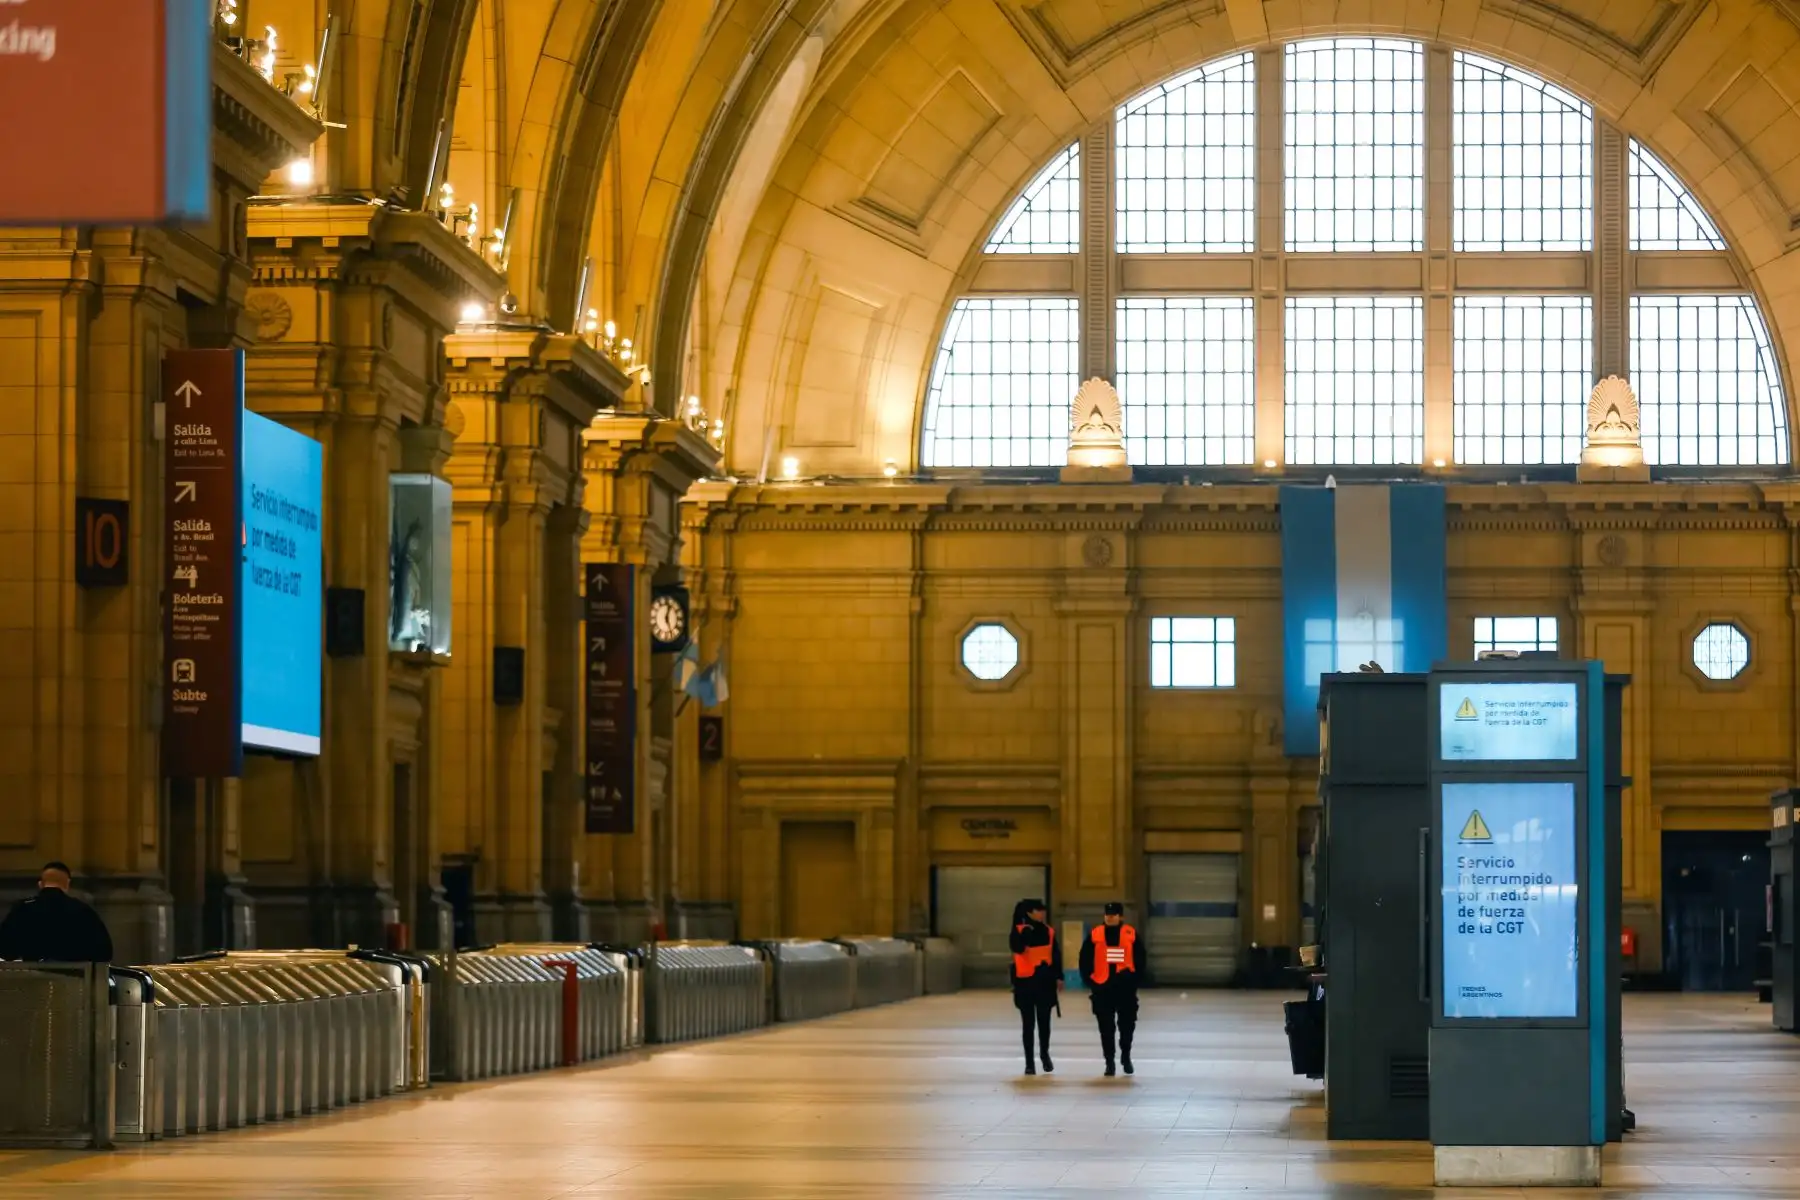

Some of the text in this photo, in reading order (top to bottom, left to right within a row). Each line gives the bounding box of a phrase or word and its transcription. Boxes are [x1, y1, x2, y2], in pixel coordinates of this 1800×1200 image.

[174, 424, 212, 436] Salida
[199, 437, 218, 445] Lima
[251, 483, 278, 517] Servicio
[174, 520, 212, 532] Salida
[86, 509, 120, 569] 10
[180, 533, 192, 541] Av.
[193, 533, 214, 541] Brasil
[252, 527, 297, 560] por medida de
[274, 566, 281, 592] de
[173, 593, 223, 604] Boletería
[172, 689, 208, 701] Subte
[1484, 700, 1516, 708] Servicio
[1523, 718, 1530, 726] la
[1457, 856, 1515, 868] Servicio
[1458, 872, 1553, 886] interrumpido
[1458, 892, 1480, 904] por
[1458, 905, 1525, 917] de fuerza
[1458, 921, 1525, 934] de la CGT
